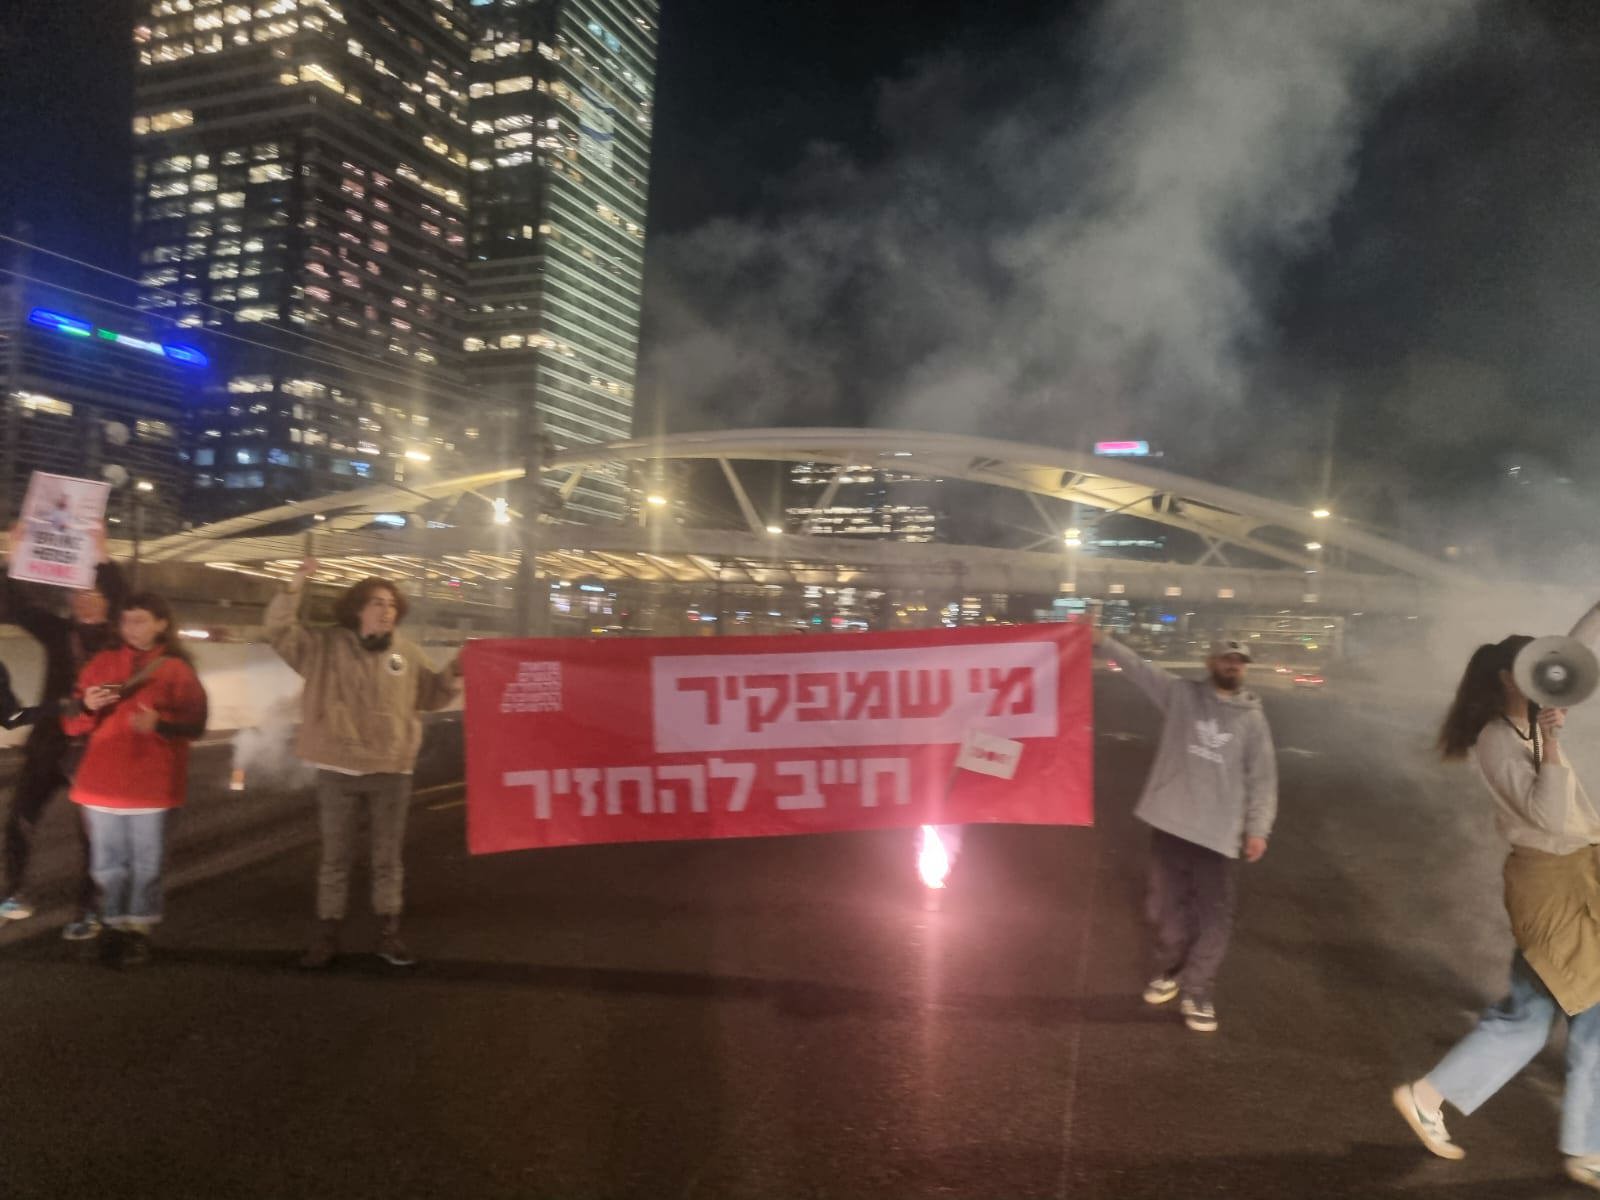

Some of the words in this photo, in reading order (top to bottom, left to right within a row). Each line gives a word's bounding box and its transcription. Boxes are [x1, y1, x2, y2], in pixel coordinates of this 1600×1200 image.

[677, 669, 953, 732] שמפקיר
[968, 667, 1033, 717] מי
[503, 758, 757, 819] להחזיר
[775, 758, 911, 810] חייב
